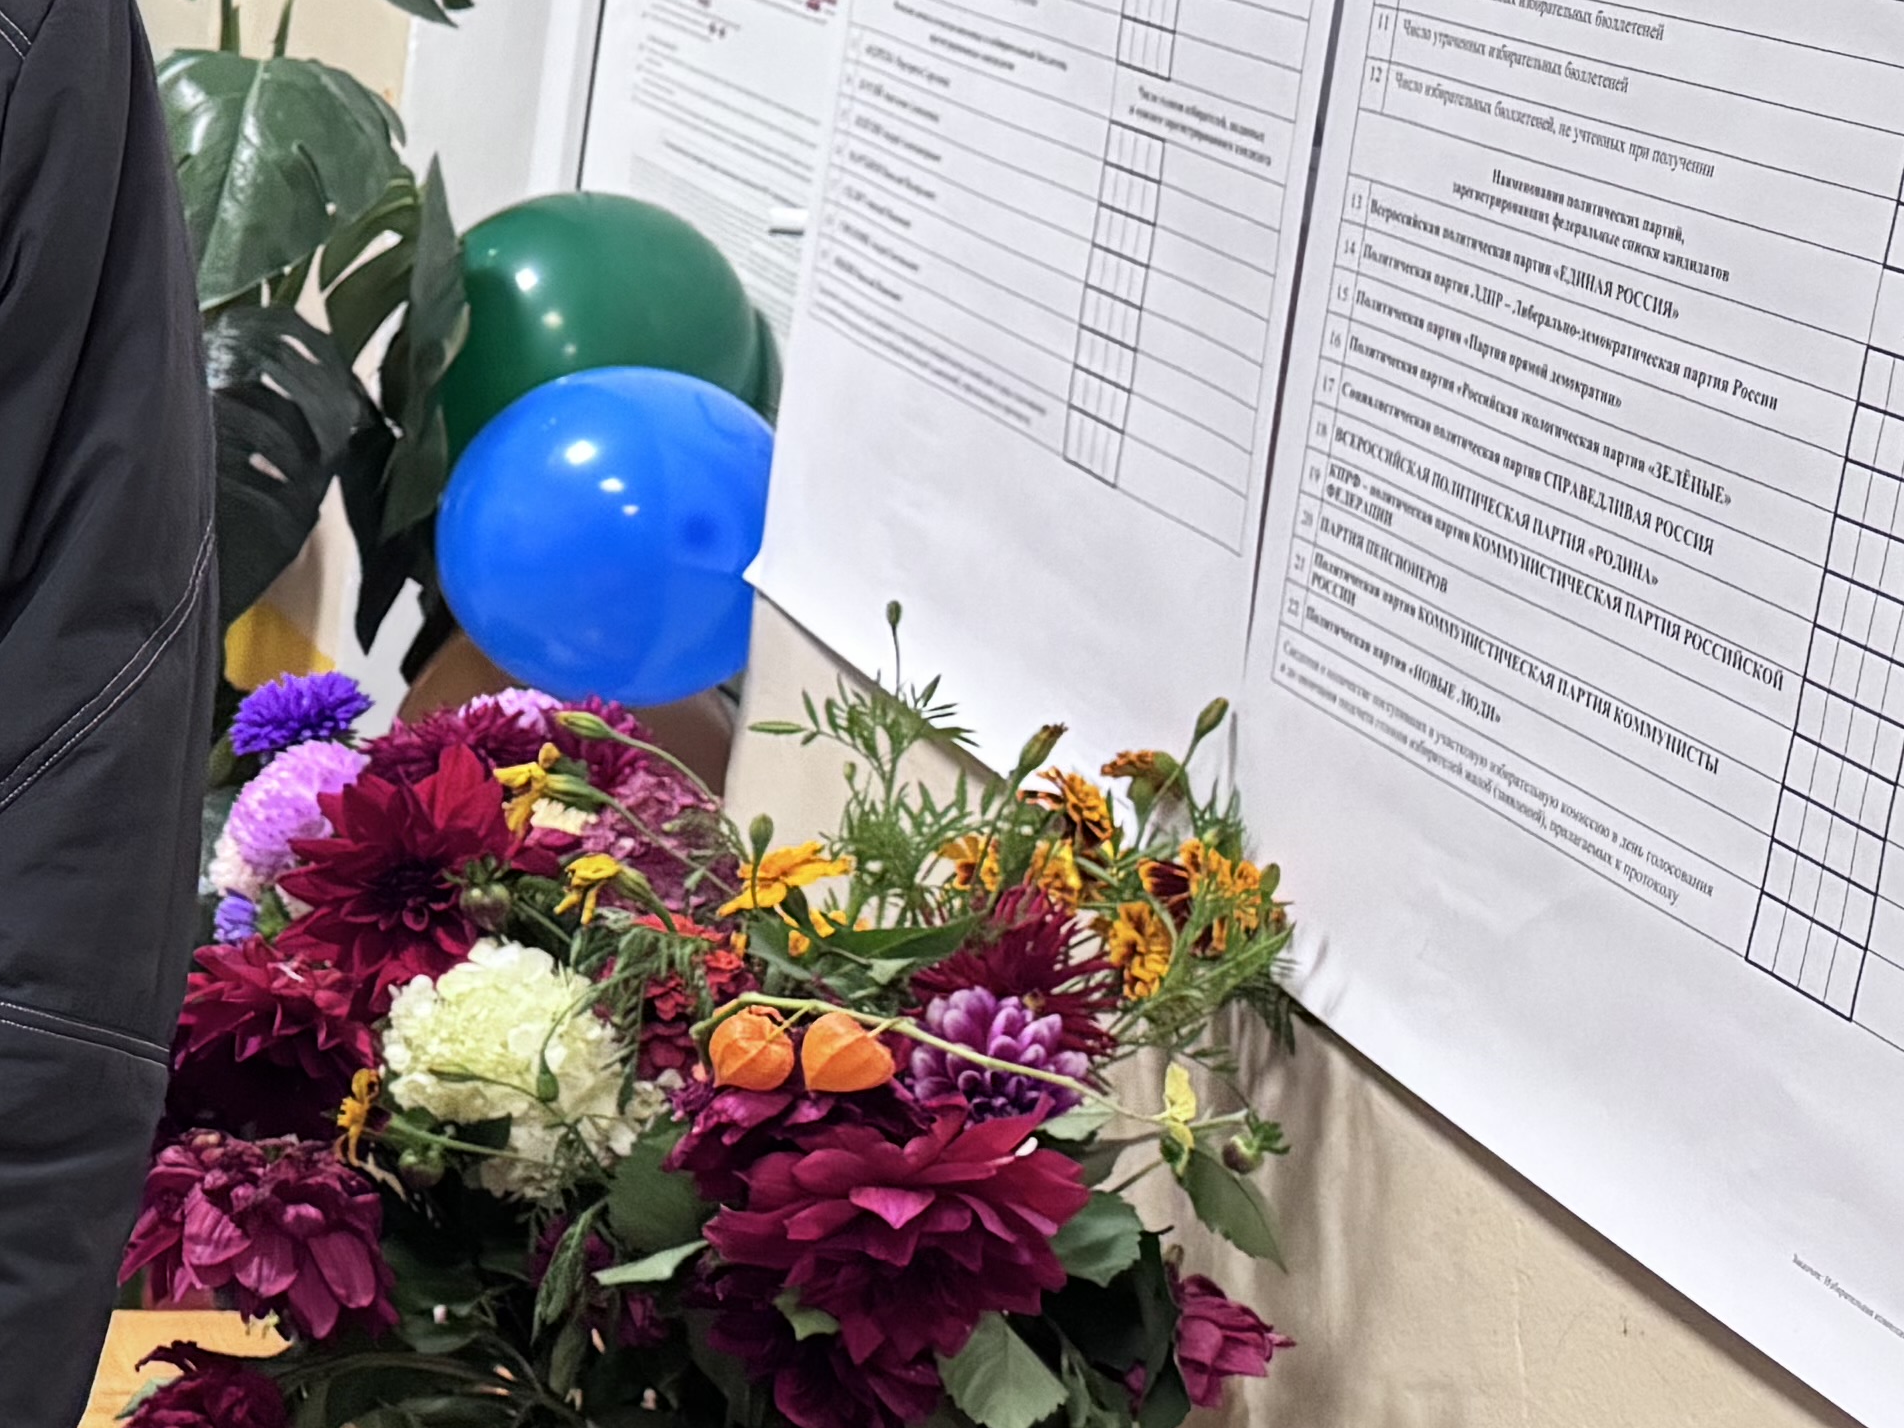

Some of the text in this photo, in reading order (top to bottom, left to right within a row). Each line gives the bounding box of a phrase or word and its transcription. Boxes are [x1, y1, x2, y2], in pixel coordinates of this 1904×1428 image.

[1513, 253, 1551, 276] партия
[1553, 264, 1613, 298] «ЕДИНАЯ
[1615, 284, 1679, 318] РОССИЯ»
[1320, 516, 1364, 550] ПАРТИЯ
[1334, 427, 1658, 584] ВСЕРОССИЙСКАЯ ПОЛИТИЧЕСКАЯ ПАРТИЯ «РОДИНА»
[1502, 456, 1541, 482] партия
[1544, 470, 1651, 529] СПРАВЕДЛИВАЯ
[1654, 516, 1714, 555] РОССИЯ
[1456, 689, 1500, 722] ЛЮДИ»
